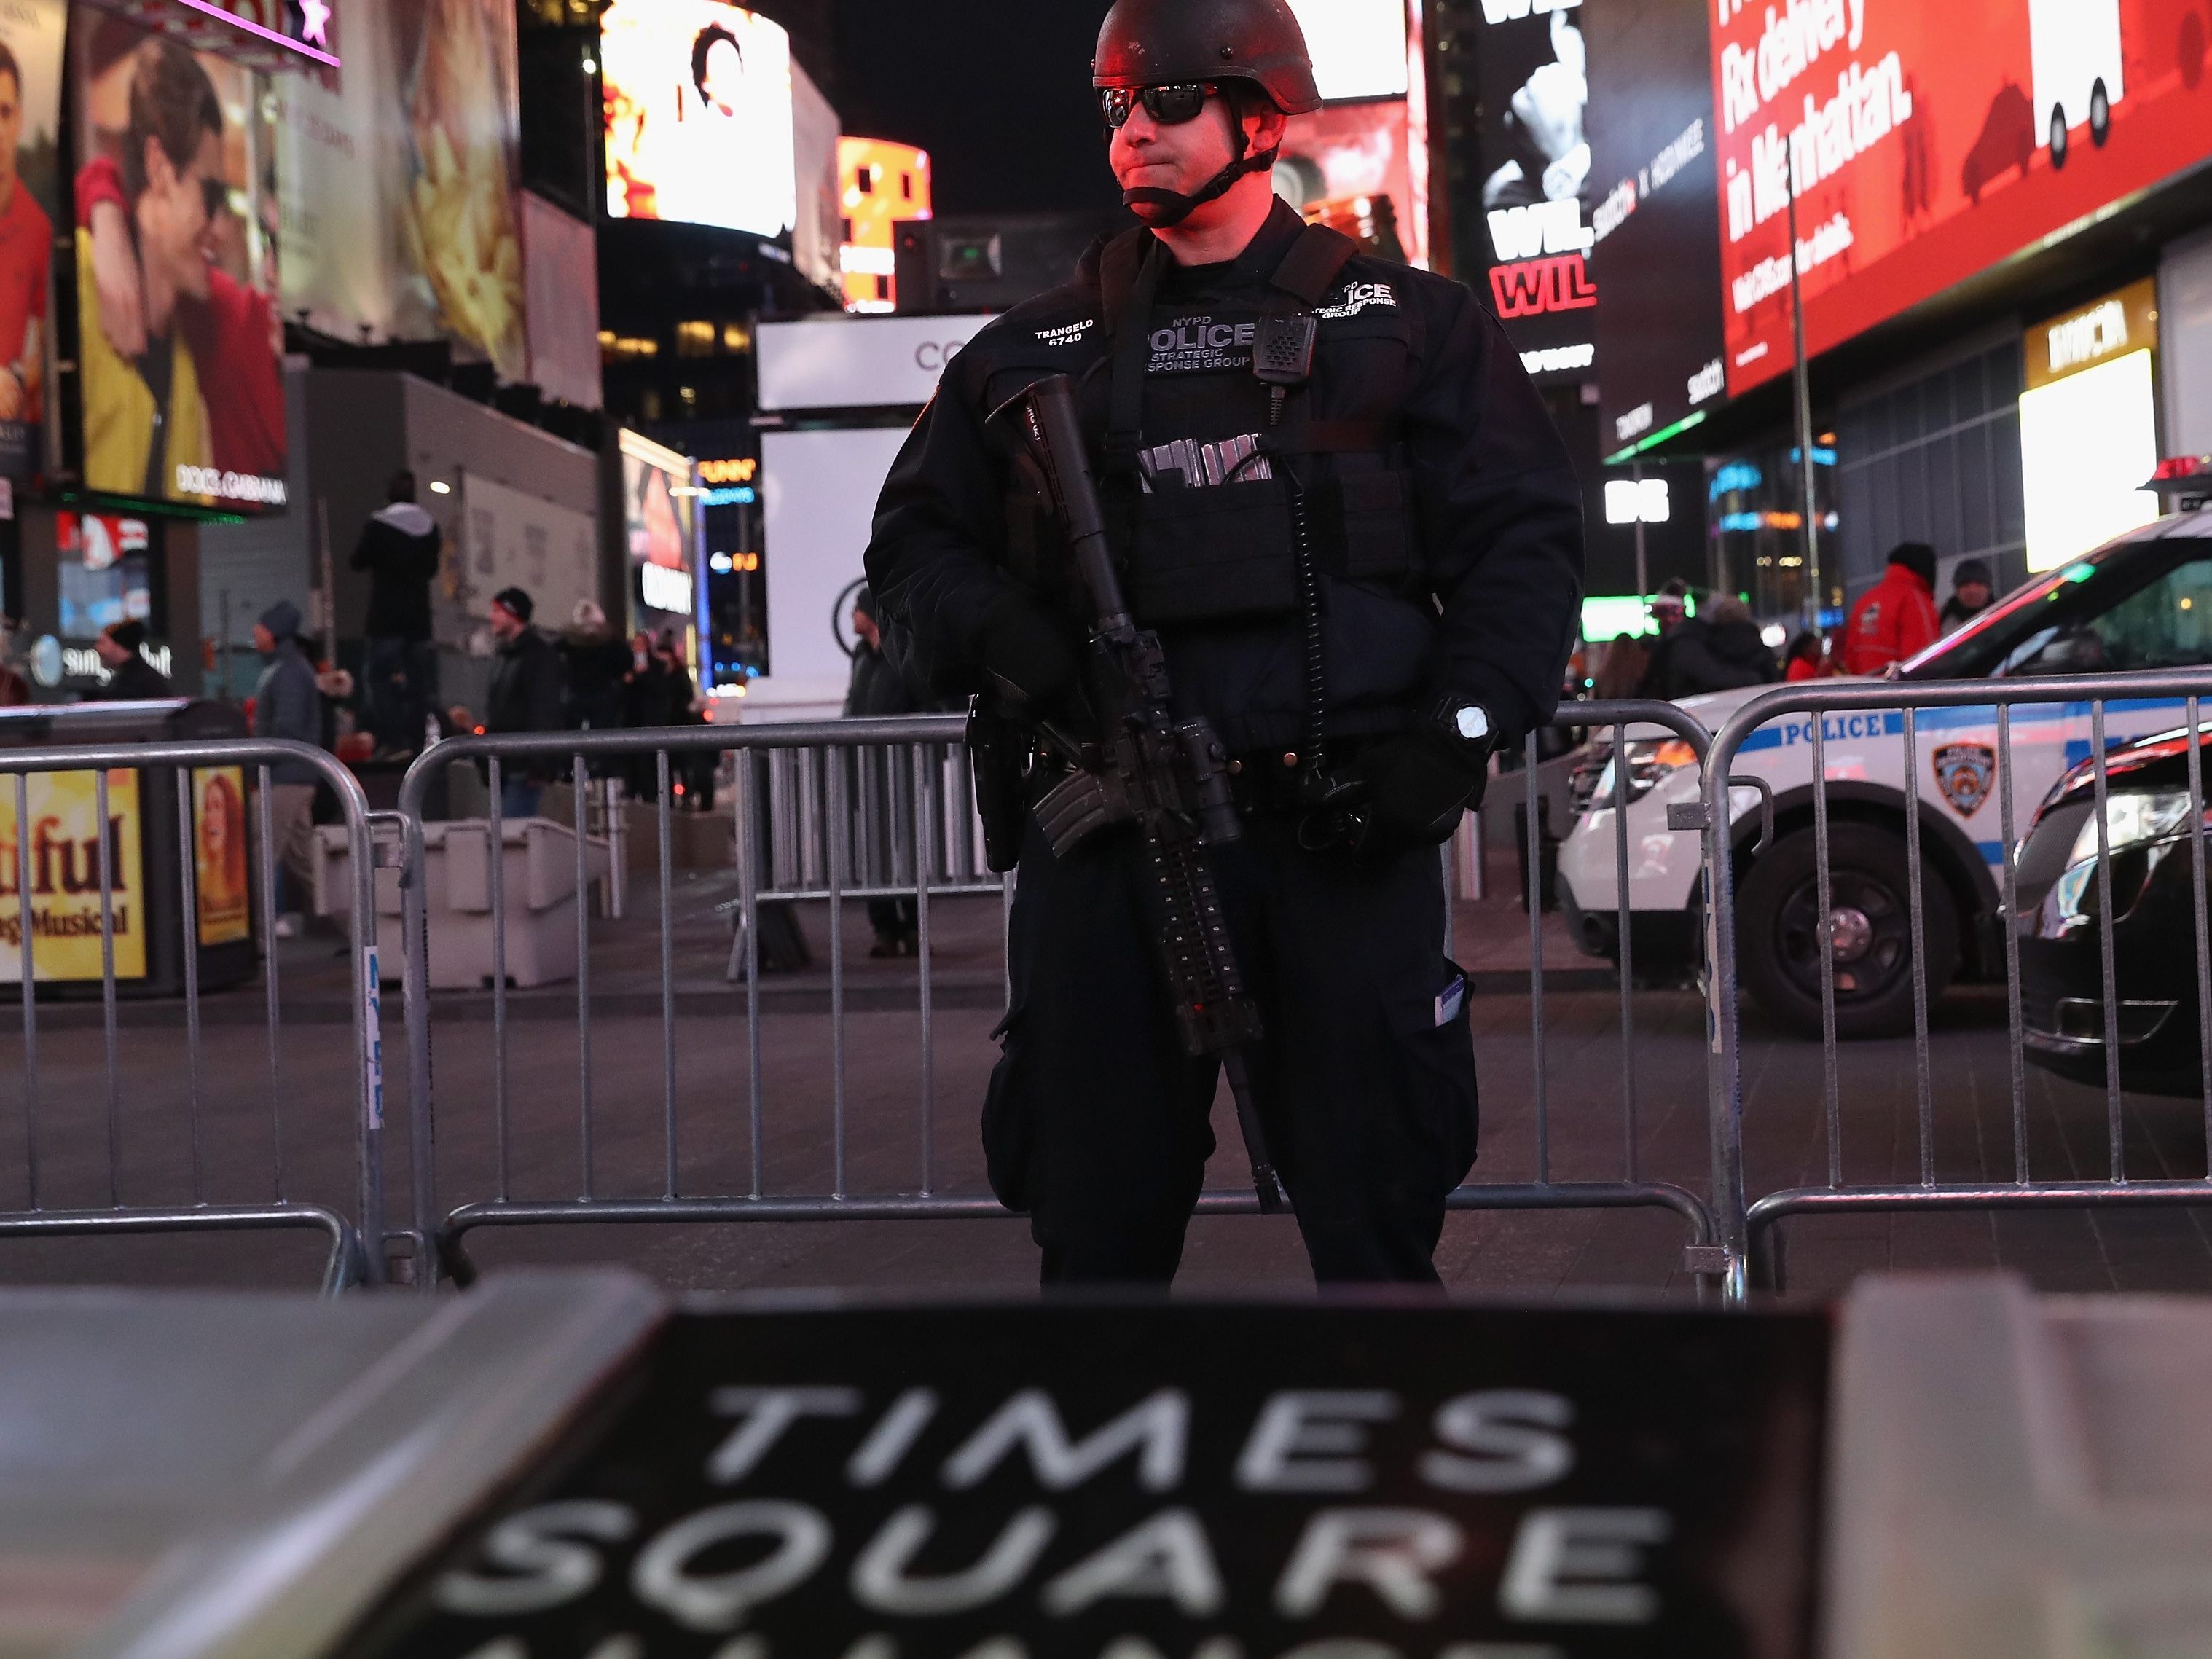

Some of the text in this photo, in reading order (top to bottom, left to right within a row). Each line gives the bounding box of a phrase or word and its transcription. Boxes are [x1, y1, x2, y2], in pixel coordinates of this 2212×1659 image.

[1721, 42, 1759, 134] Rx
[1726, 157, 1753, 243] in
[1345, 283, 1392, 305] ICE
[1345, 297, 1397, 312] RESPONSE
[1172, 316, 1212, 327] NYPD
[1322, 307, 1361, 319] GROUP
[1035, 319, 1093, 339] TRANGELO
[1048, 332, 1082, 346] 6740
[1148, 323, 1255, 351] OLICE
[1146, 357, 1250, 372] SPONSE GROUP
[1151, 349, 1223, 362] STRATEGIC
[1786, 714, 1880, 745] POLICE
[709, 1386, 1576, 1489] TIMES
[439, 1497, 1673, 1632] SQUARE
